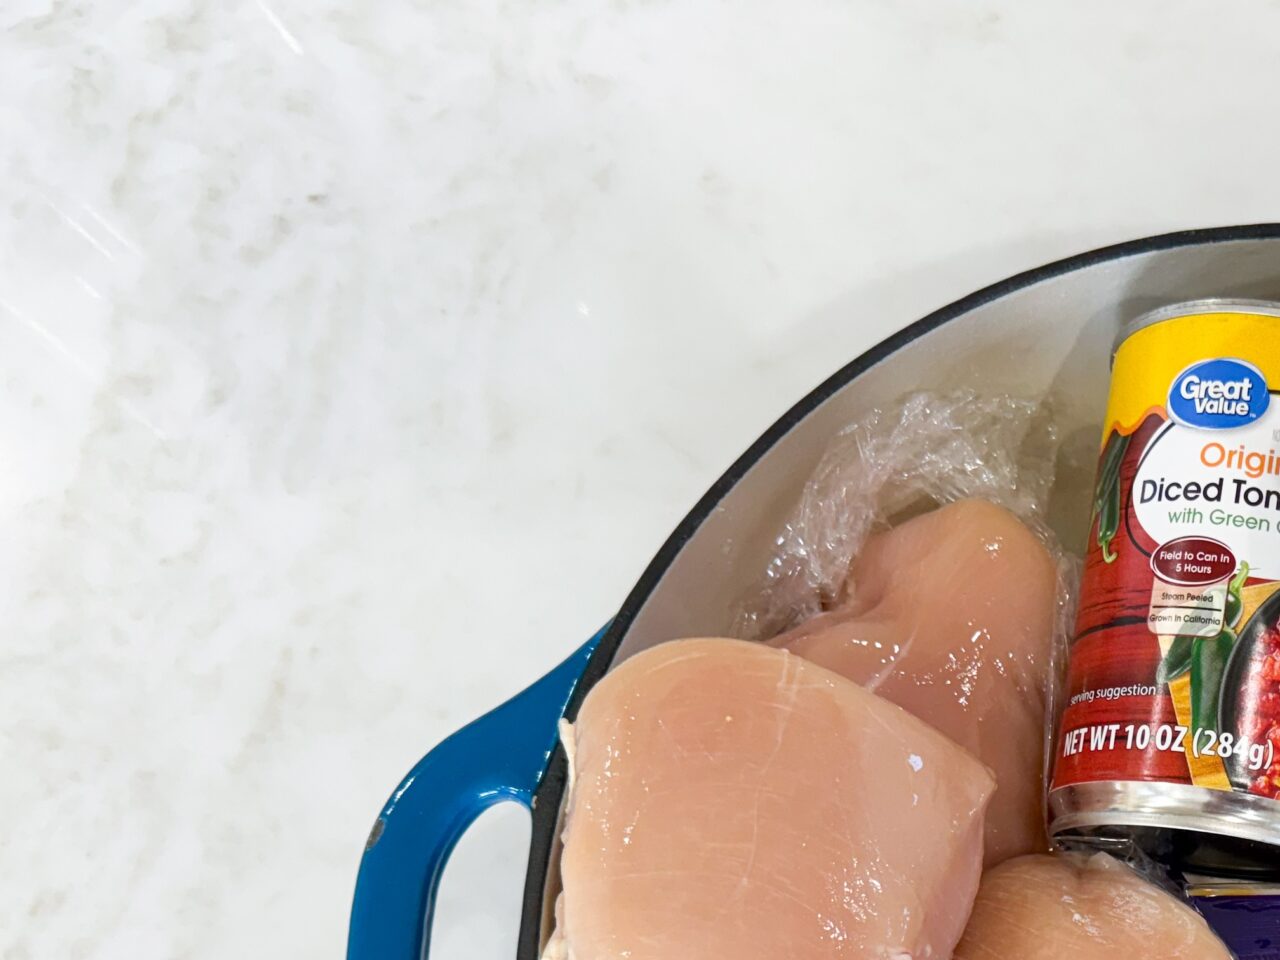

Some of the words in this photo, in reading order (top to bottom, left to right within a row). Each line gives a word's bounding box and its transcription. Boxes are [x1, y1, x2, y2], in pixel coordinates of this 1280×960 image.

[1180, 375, 1253, 402] Great
[1194, 398, 1249, 416] Value
[1140, 478, 1223, 504] Diced
[1168, 507, 1203, 525] with
[1210, 508, 1271, 532] Green
[1160, 551, 1182, 560] Field
[1184, 552, 1194, 561] to
[1197, 552, 1217, 562] Can
[1175, 563, 1182, 572] 5
[1184, 564, 1212, 574] Hours
[1161, 592, 1185, 601] Steam
[1186, 593, 1214, 603] Peeled
[1149, 614, 1173, 623] Grown
[1183, 614, 1221, 626] California
[1096, 684, 1156, 701] suggestion
[1063, 728, 1088, 758] NET
[1089, 725, 1119, 751] WT
[1124, 725, 1151, 751] 10
[1155, 724, 1189, 753] OZ
[1192, 727, 1275, 771] (284g)
